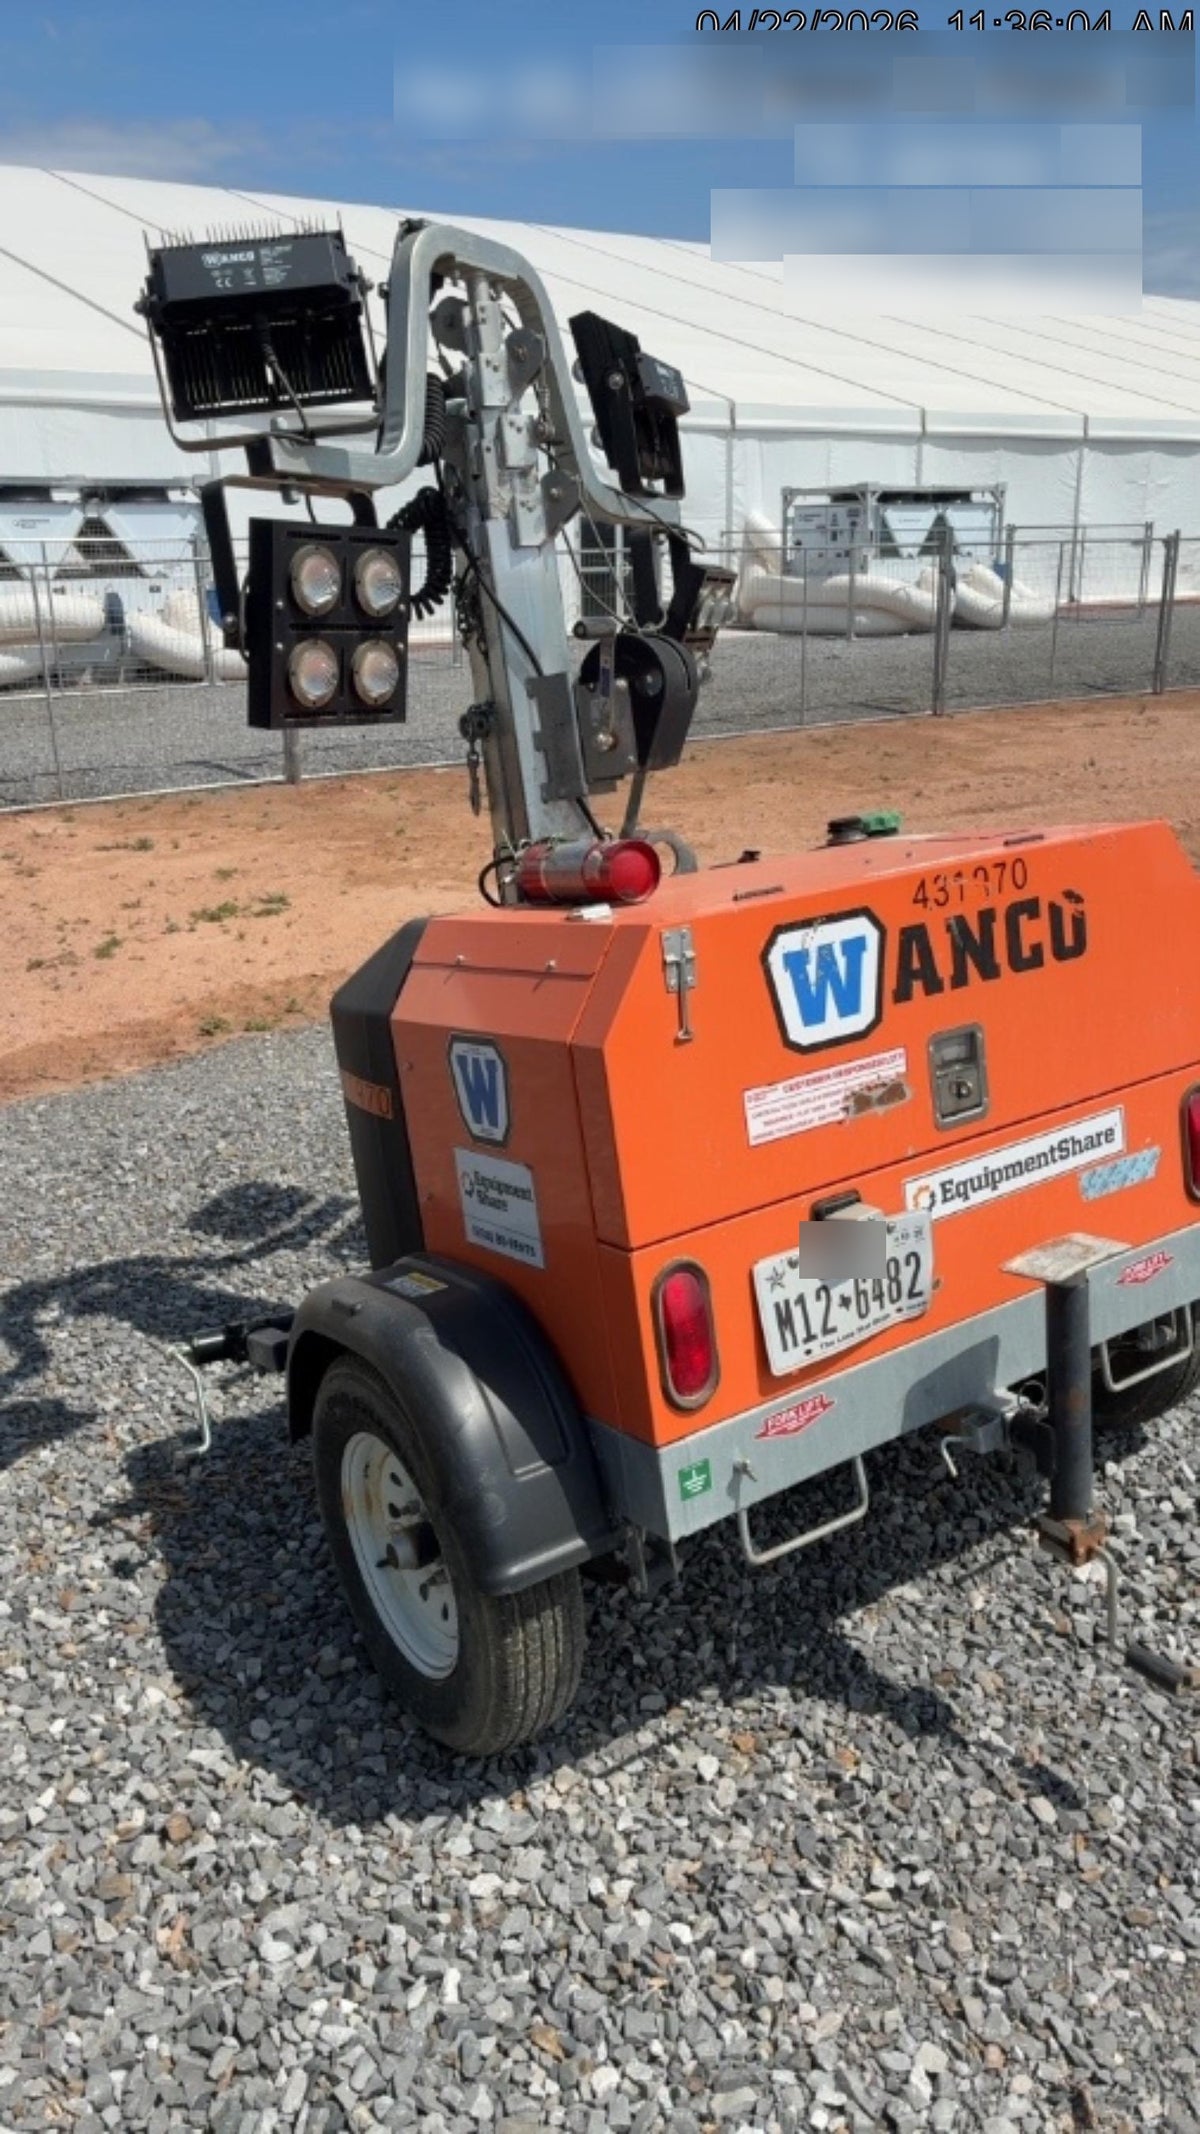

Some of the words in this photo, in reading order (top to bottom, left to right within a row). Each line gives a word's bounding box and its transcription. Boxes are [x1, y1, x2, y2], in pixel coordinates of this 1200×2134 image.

[782, 889, 1088, 1028] WANCO
[456, 1054, 498, 1129] W
[939, 1126, 1116, 1204] EquipmentShare
[774, 1284, 838, 1352] M12
[854, 1251, 924, 1319] 6482
